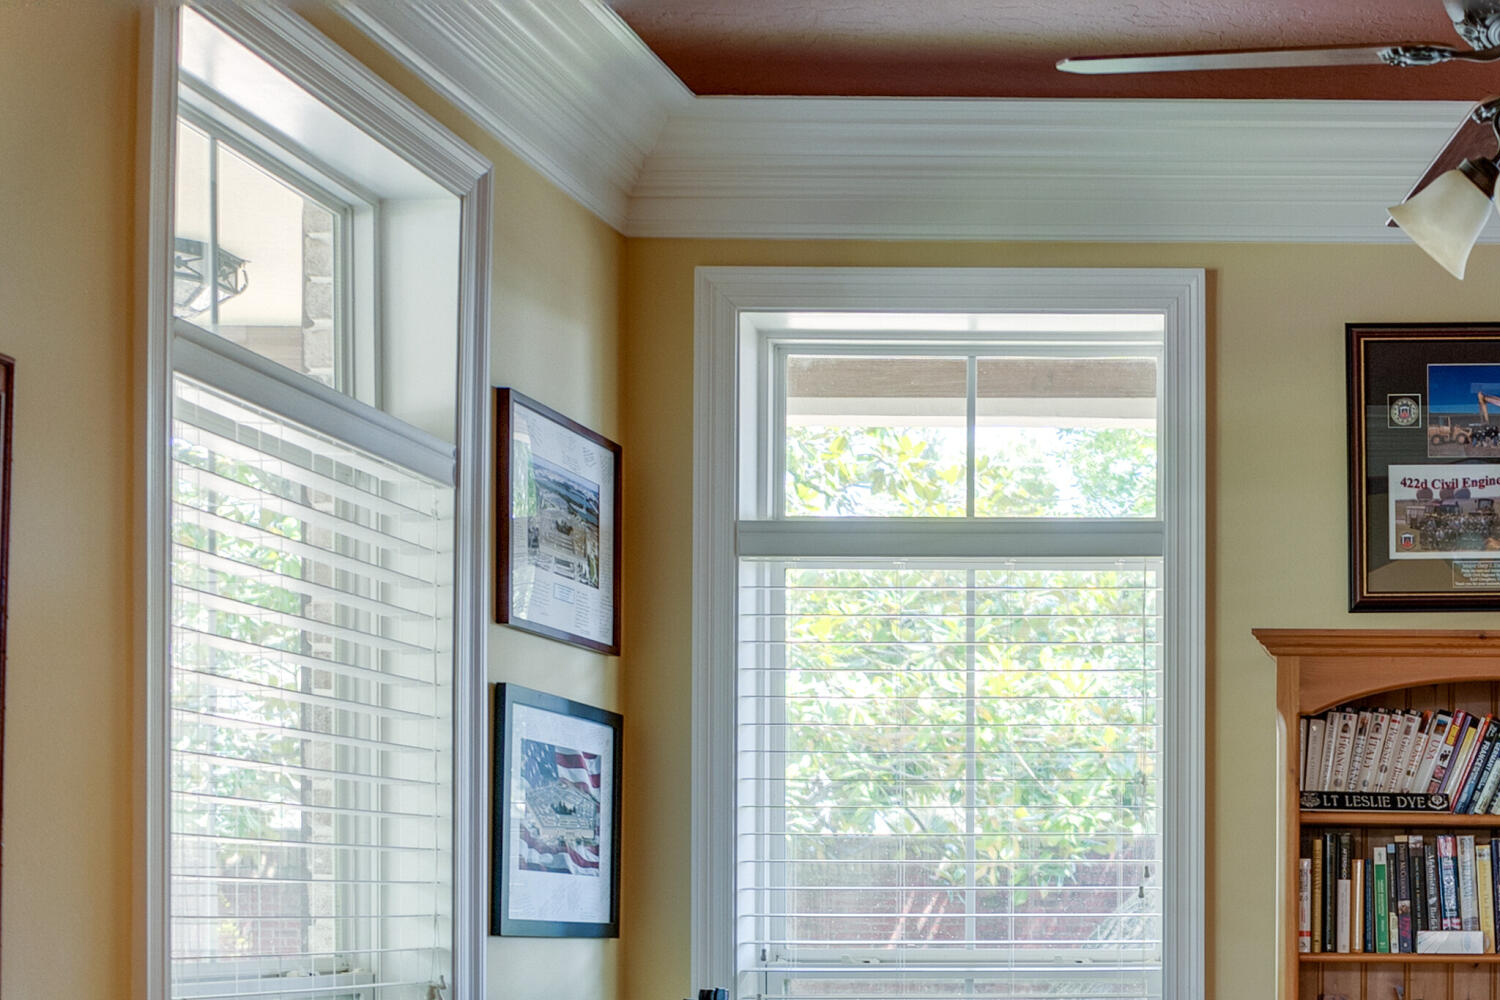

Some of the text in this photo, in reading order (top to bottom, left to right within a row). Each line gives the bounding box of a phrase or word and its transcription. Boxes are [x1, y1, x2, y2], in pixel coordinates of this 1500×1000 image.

[1400, 477, 1428, 489] 422d
[1431, 477, 1458, 490] Civil
[1334, 735, 1351, 777] FRANCE
[1363, 736, 1382, 768] ITALY
[1426, 739, 1440, 760] USA
[1475, 740, 1491, 768] FRANCE
[1323, 795, 1426, 808] LT LESLIE DYE
